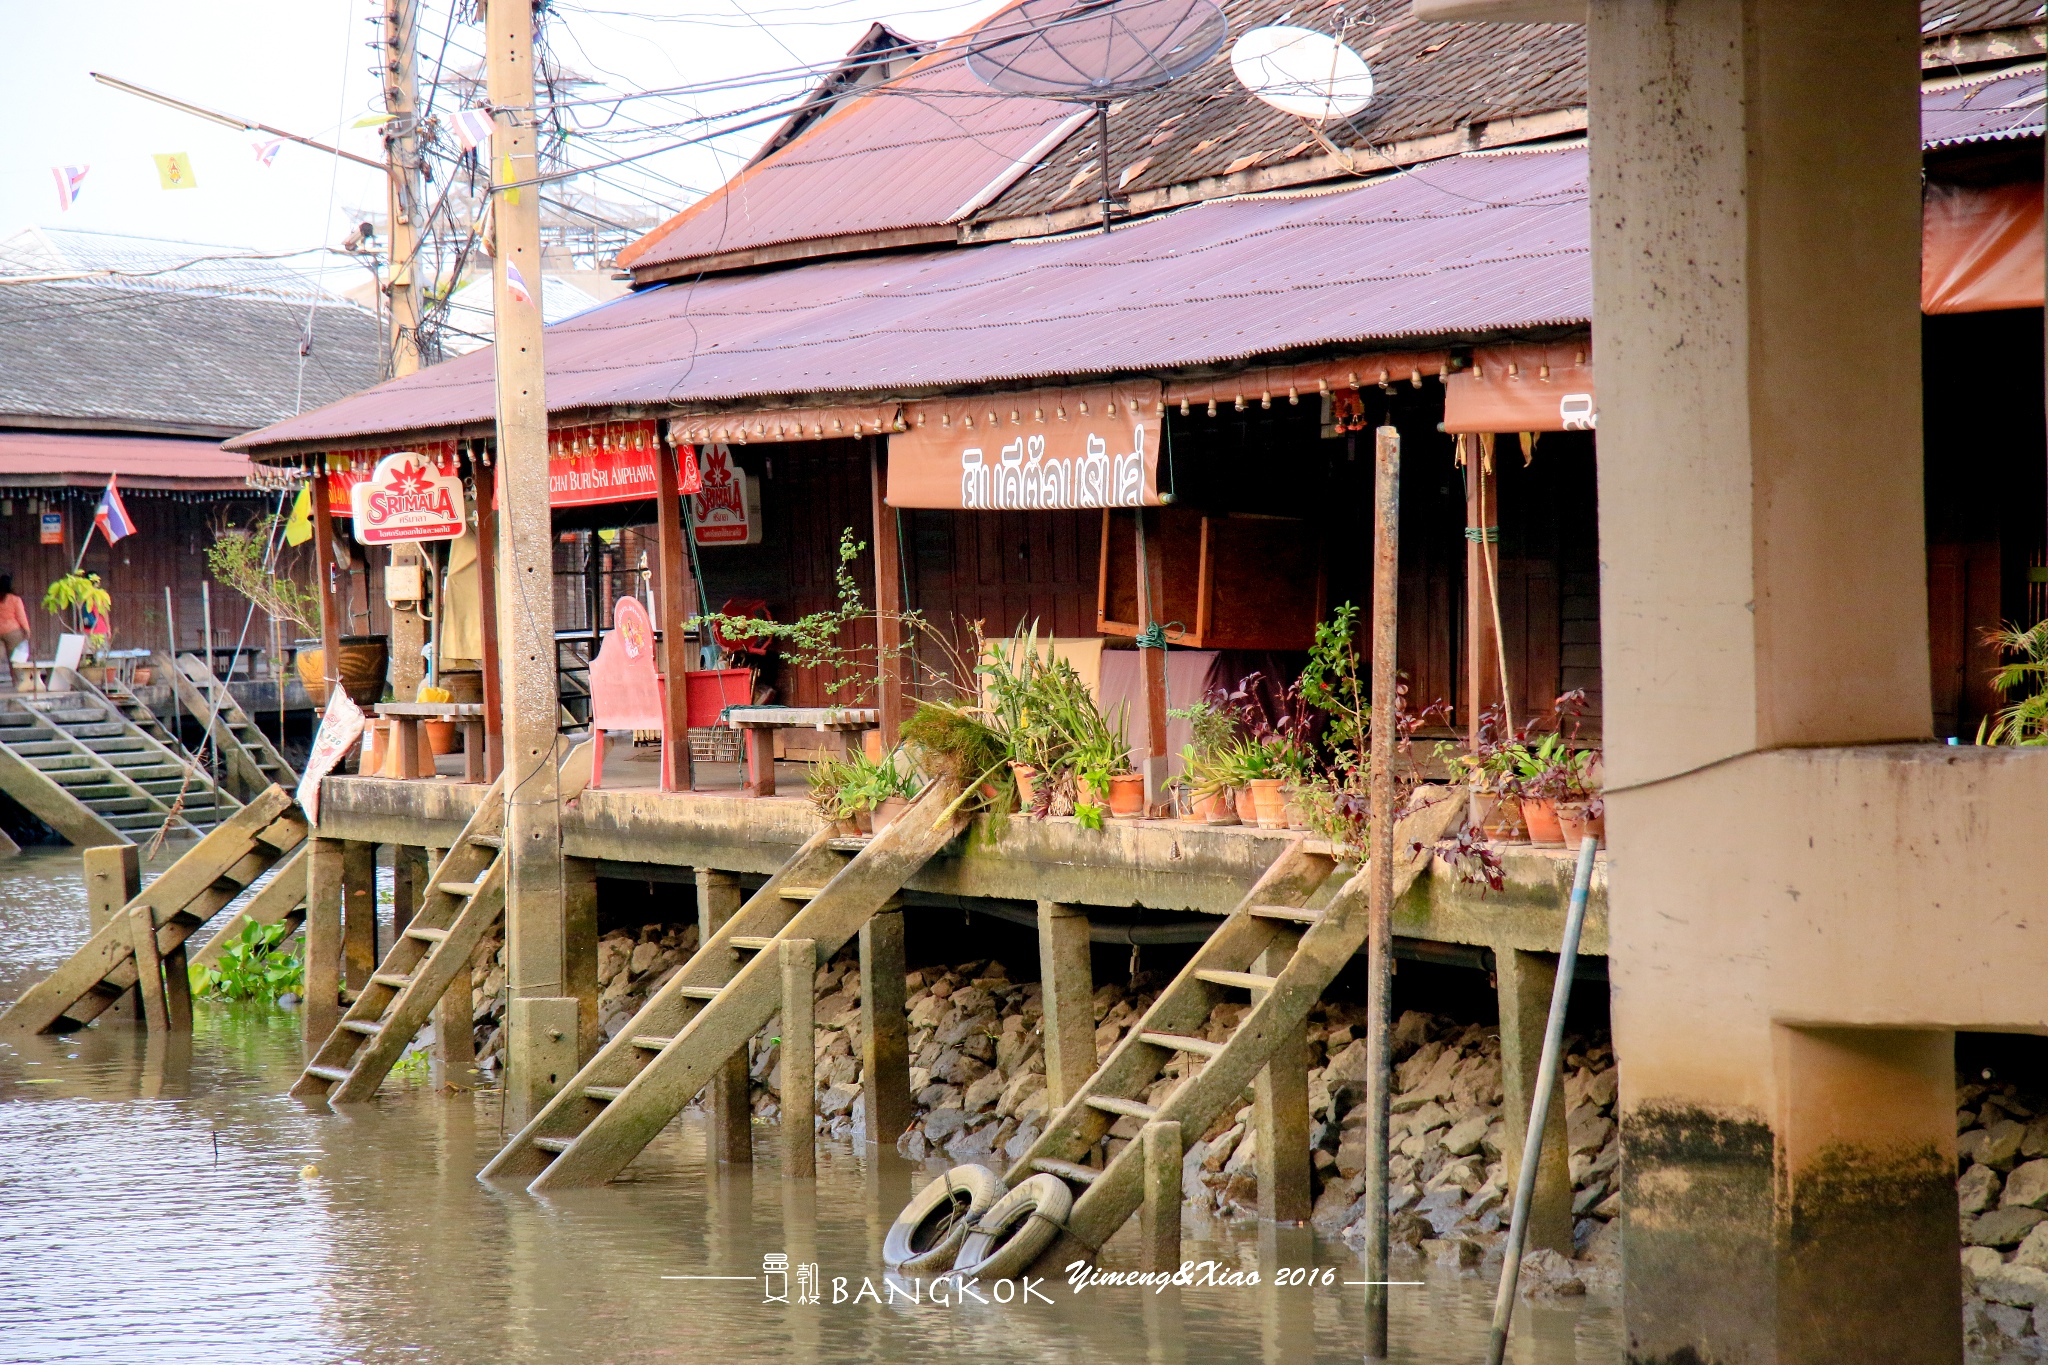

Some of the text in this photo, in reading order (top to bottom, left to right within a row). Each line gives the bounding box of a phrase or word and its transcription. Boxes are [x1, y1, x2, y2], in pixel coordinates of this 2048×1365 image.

[549, 464, 656, 492] CHAI BURI SRI AMPHAWA
[962, 424, 1146, 509] ยินดีต้อนรับส่
[367, 487, 458, 525] SRIMALA
[695, 479, 745, 523] SRIMALA
